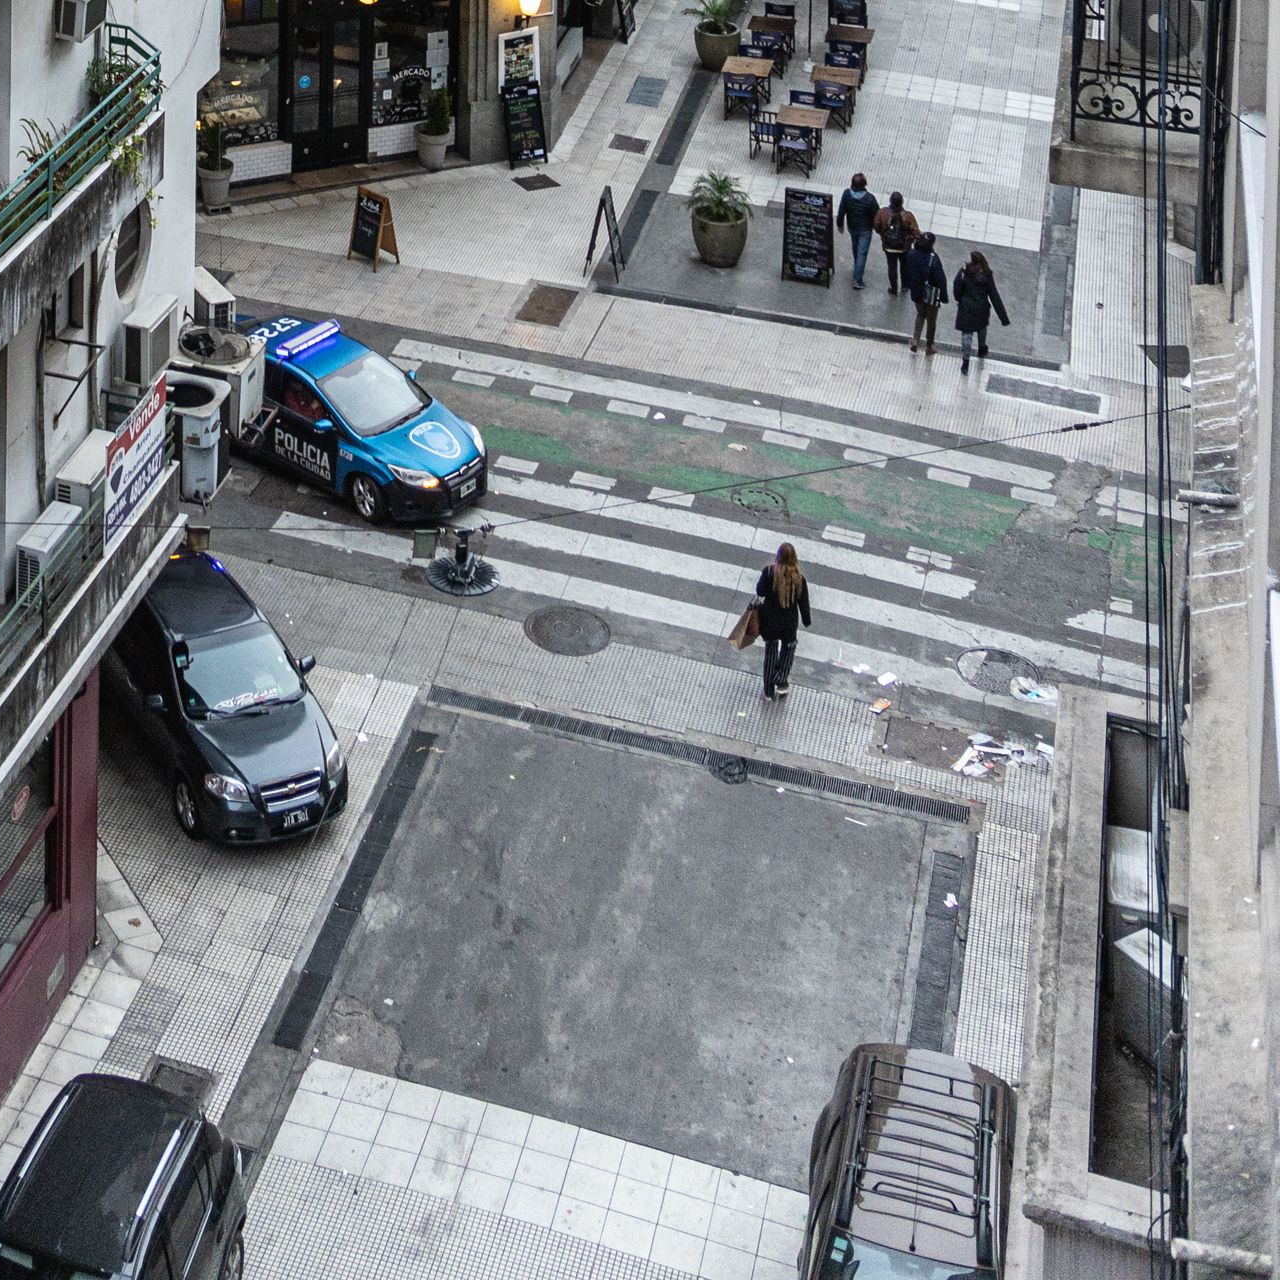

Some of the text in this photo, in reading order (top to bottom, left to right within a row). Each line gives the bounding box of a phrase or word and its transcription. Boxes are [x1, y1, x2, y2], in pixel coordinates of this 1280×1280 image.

[392, 65, 430, 83] MERCADO
[213, 93, 254, 110] MERCADO
[129, 391, 160, 441] Vende
[274, 427, 331, 471] POLICIA
[275, 444, 332, 482] DE LA CIUDAD
